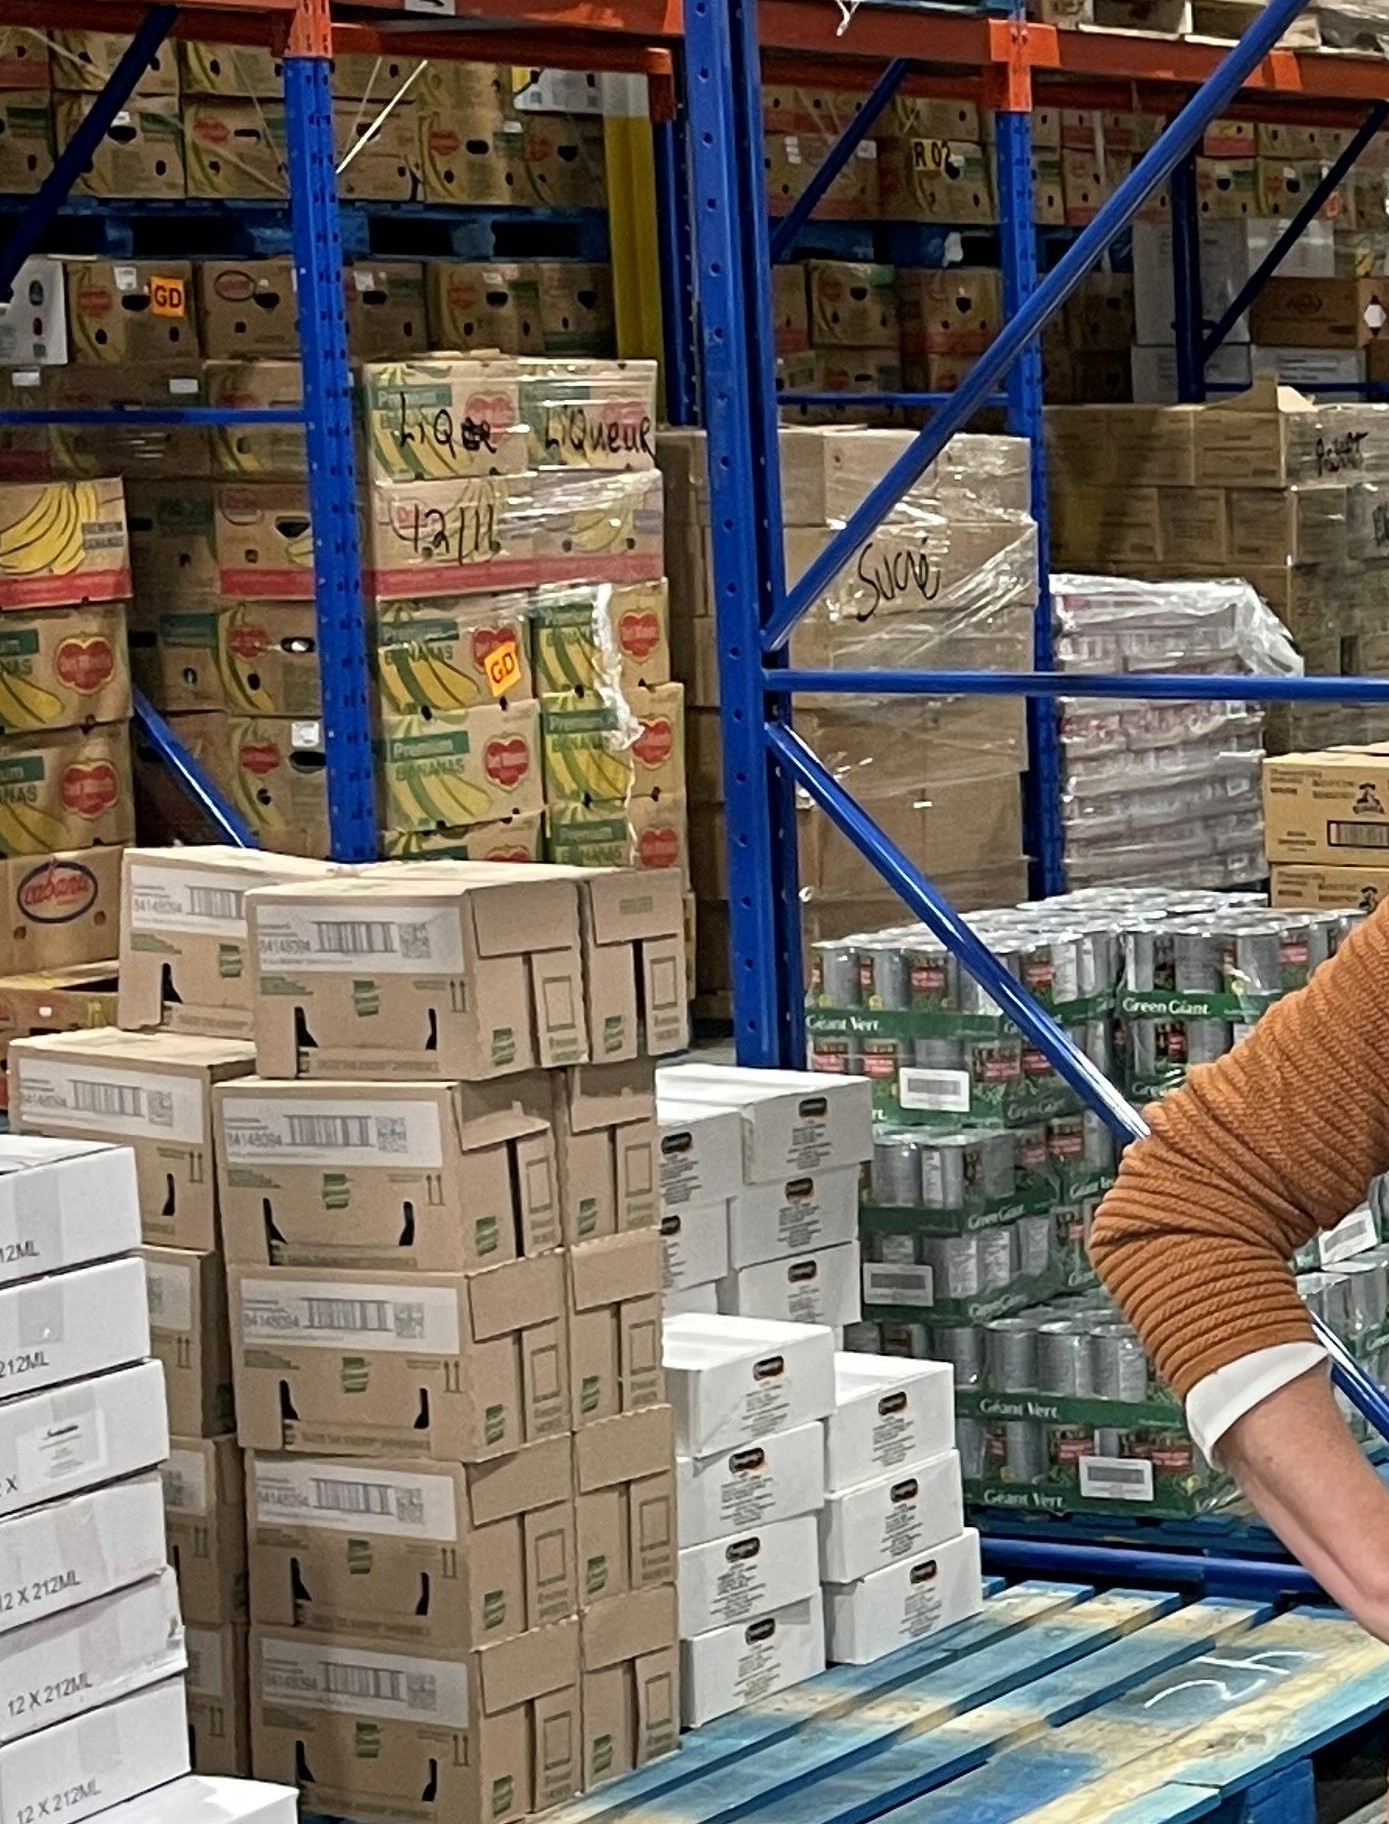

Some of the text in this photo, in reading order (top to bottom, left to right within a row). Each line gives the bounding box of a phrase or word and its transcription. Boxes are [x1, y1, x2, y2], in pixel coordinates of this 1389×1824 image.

[154, 285, 182, 308] GD
[490, 652, 516, 684] GD
[1122, 997, 1209, 1015] Green Giant
[805, 1014, 880, 1032] Géant Vert
[1027, 1401, 1058, 1418] Vert
[1032, 1493, 1063, 1509] Vert
[17, 1587, 30, 1605] X
[33, 1569, 81, 1600] 212ML
[8, 1671, 93, 1717] 12 X 212ML
[17, 1777, 102, 1824] 12 X 212ML
